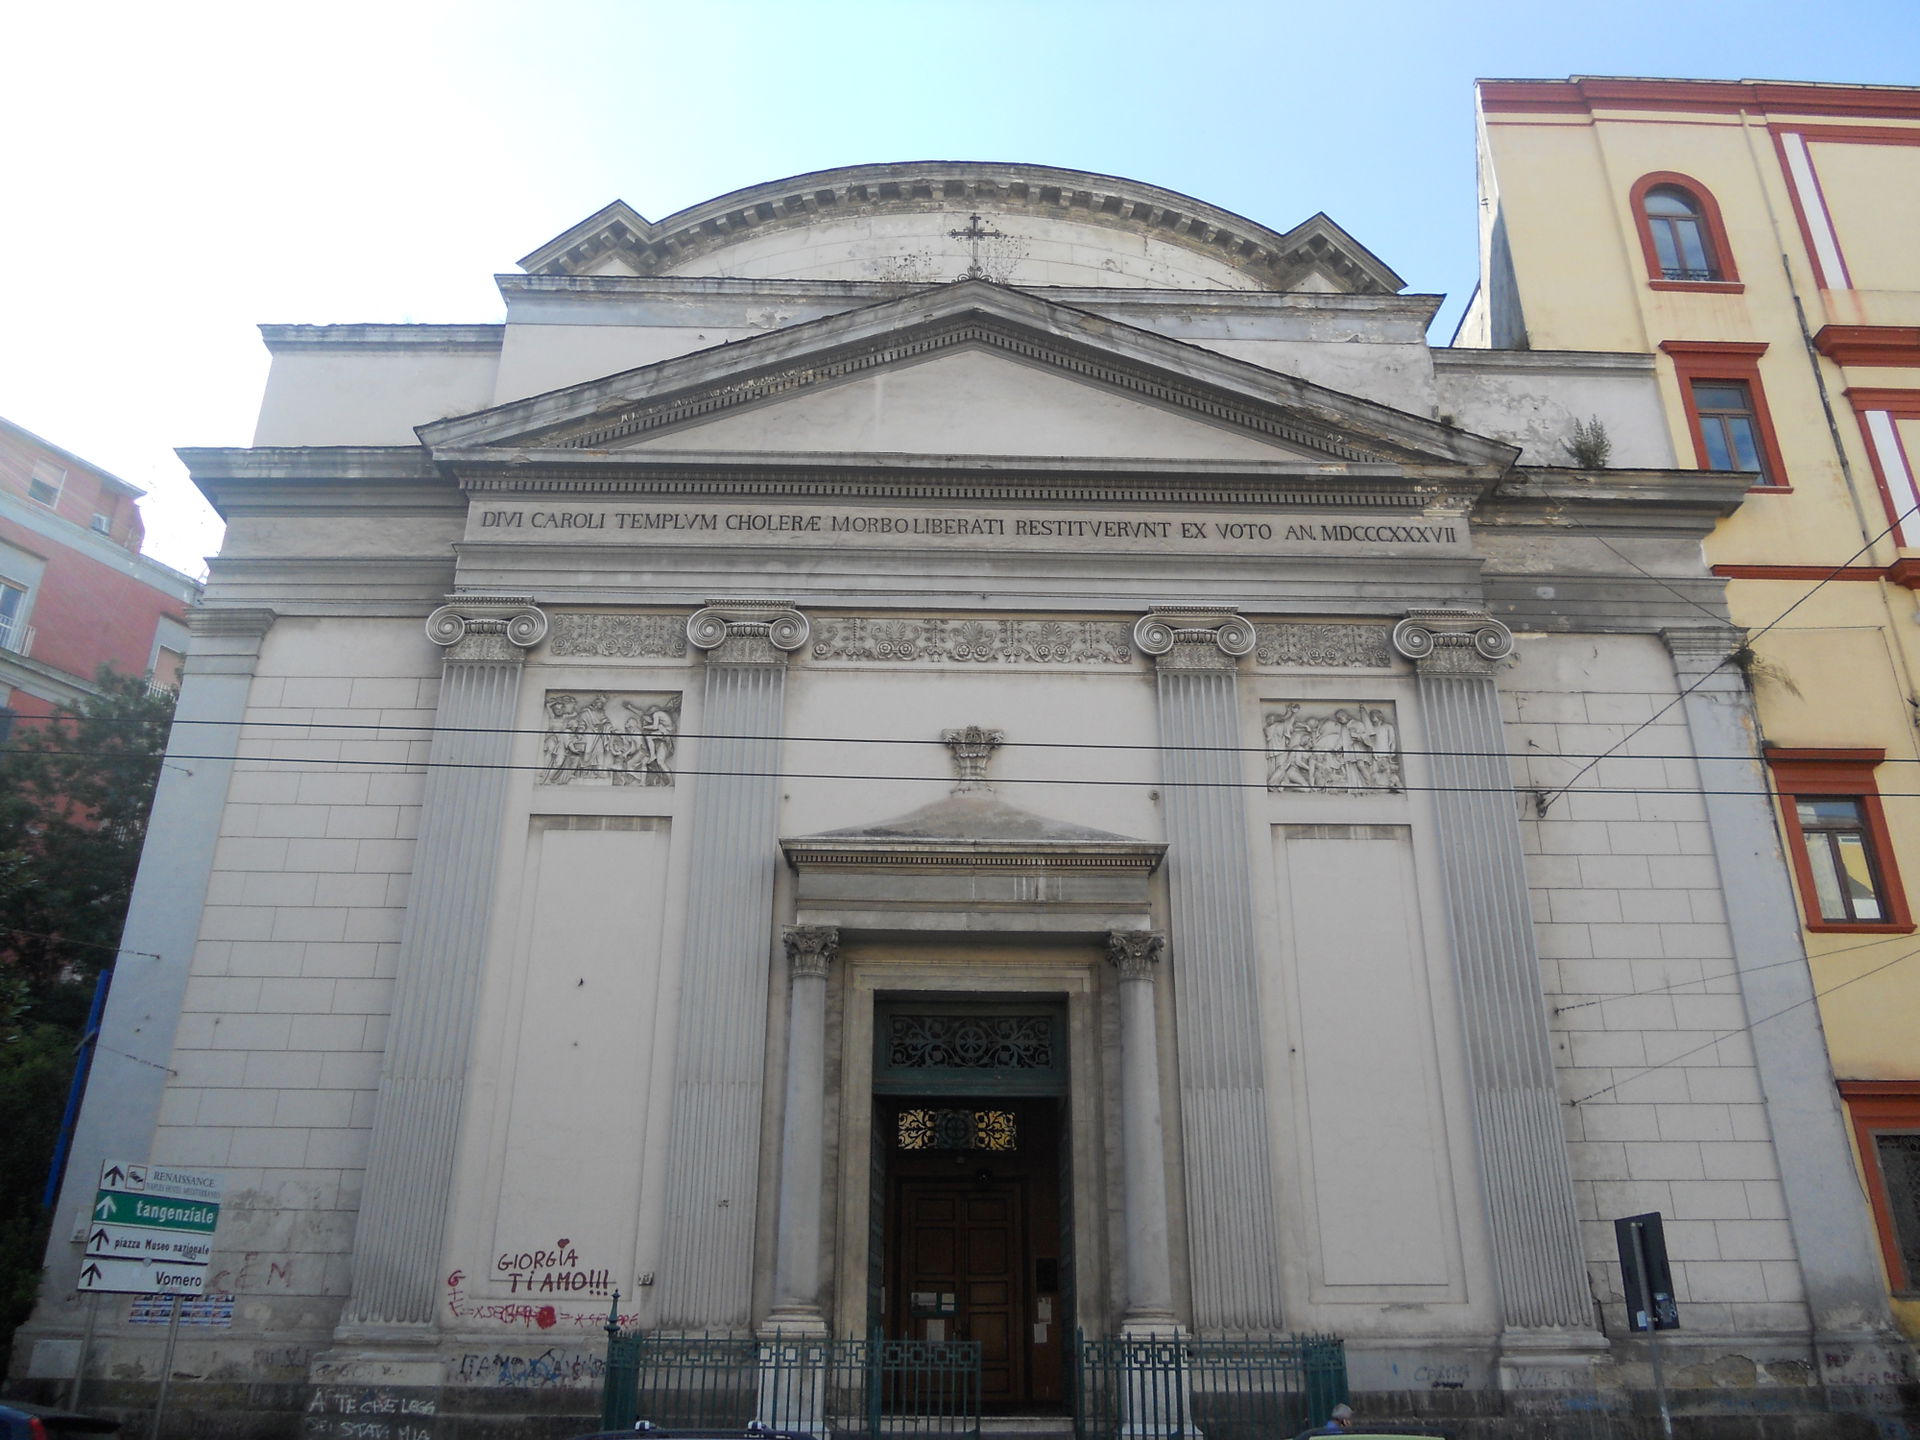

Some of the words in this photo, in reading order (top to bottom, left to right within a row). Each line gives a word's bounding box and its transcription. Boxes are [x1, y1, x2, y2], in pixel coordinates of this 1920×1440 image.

[481, 511, 524, 528] DIVI
[531, 512, 605, 529] CAROLI
[615, 513, 718, 530] TEMPLVM
[726, 514, 822, 532] CHOLERÆ
[832, 516, 909, 534] MORBO
[913, 518, 1004, 536] LIBERATI
[1015, 519, 1172, 539] RESTITVERVNT
[1181, 523, 1208, 540] EX
[1215, 523, 1272, 541] VOTO
[1285, 525, 1316, 542] AN.
[1322, 525, 1456, 543] MDCCCXXXVII
[153, 1170, 216, 1189] RENAISSANCE
[136, 1200, 215, 1224] tangenziale
[114, 1237, 141, 1251] piazza
[145, 1239, 170, 1252] Museo
[173, 1243, 210, 1256] nazionale
[497, 1248, 578, 1272] GIORGIA
[156, 1271, 202, 1287] Vomero
